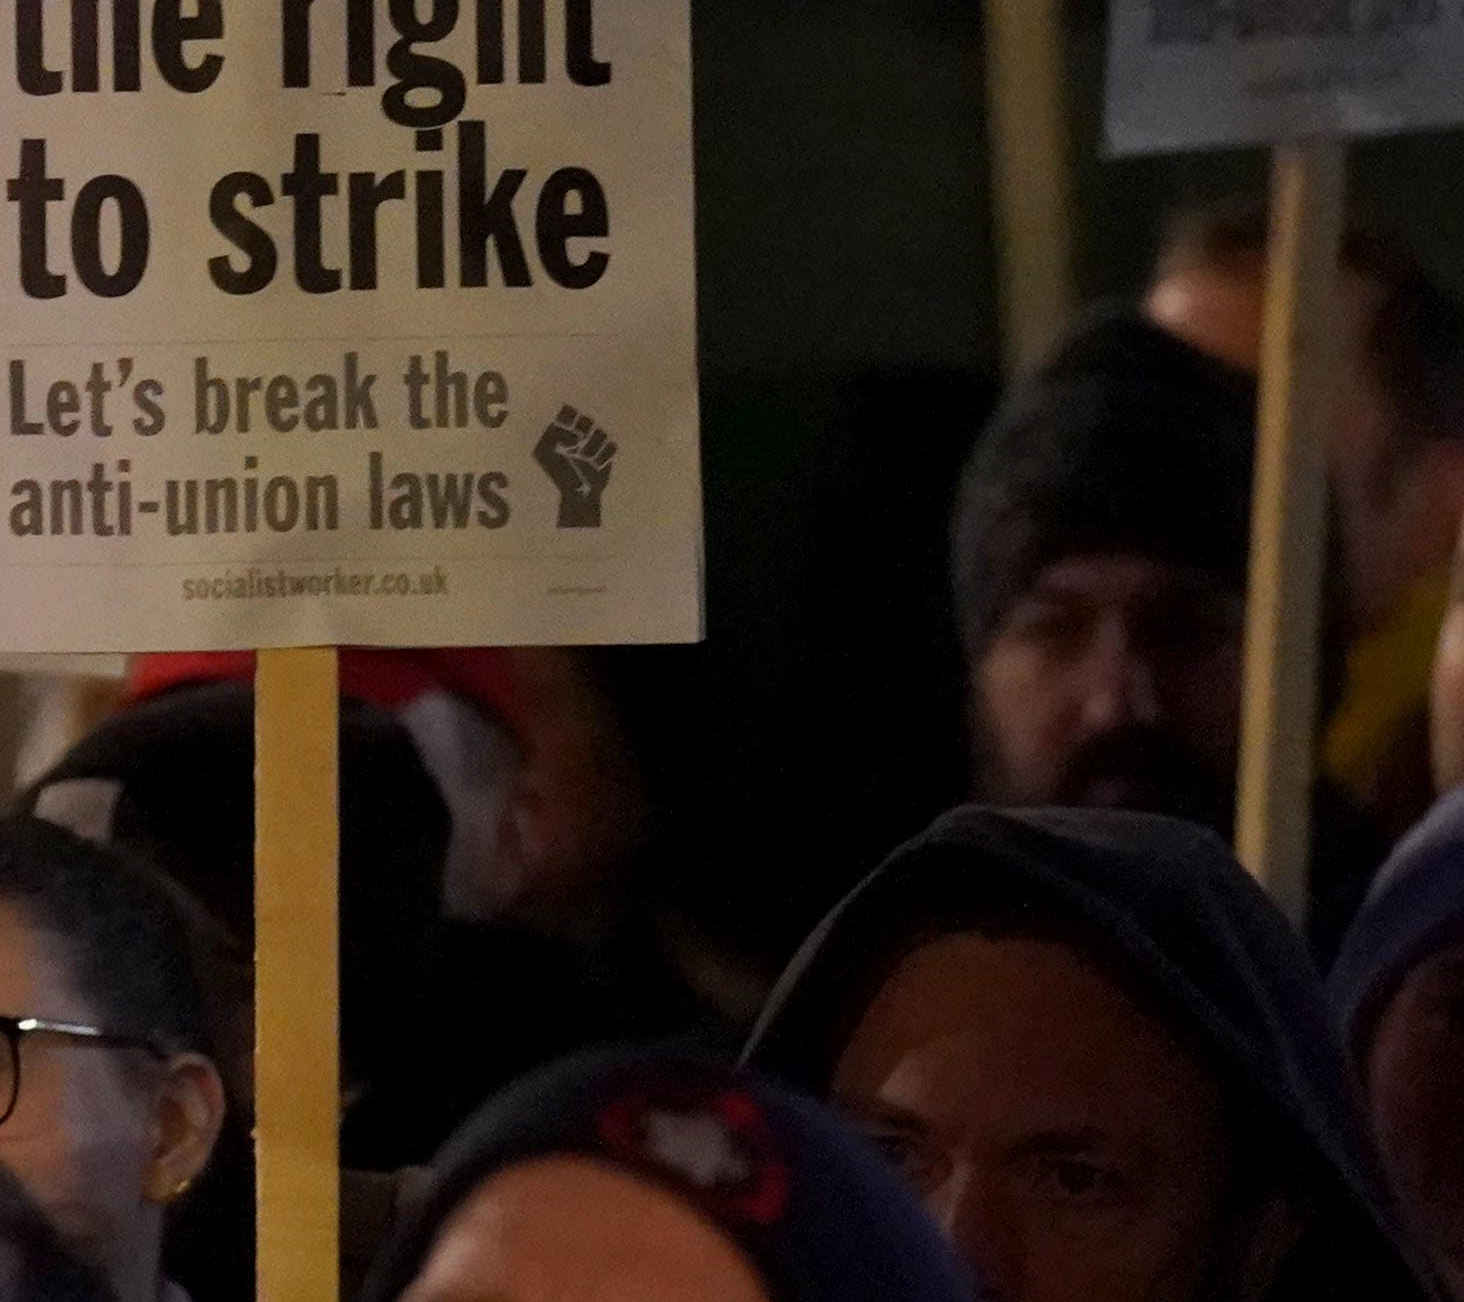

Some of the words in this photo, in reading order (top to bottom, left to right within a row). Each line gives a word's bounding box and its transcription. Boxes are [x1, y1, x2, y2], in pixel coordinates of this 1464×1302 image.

[6, 137, 151, 300] to
[206, 119, 613, 296] strike
[8, 357, 168, 439] Let's
[194, 349, 380, 436] break
[405, 349, 509, 430] the
[8, 455, 339, 538] anti-union
[369, 450, 511, 531] laws
[181, 568, 449, 604] socialistworker.co.uk
